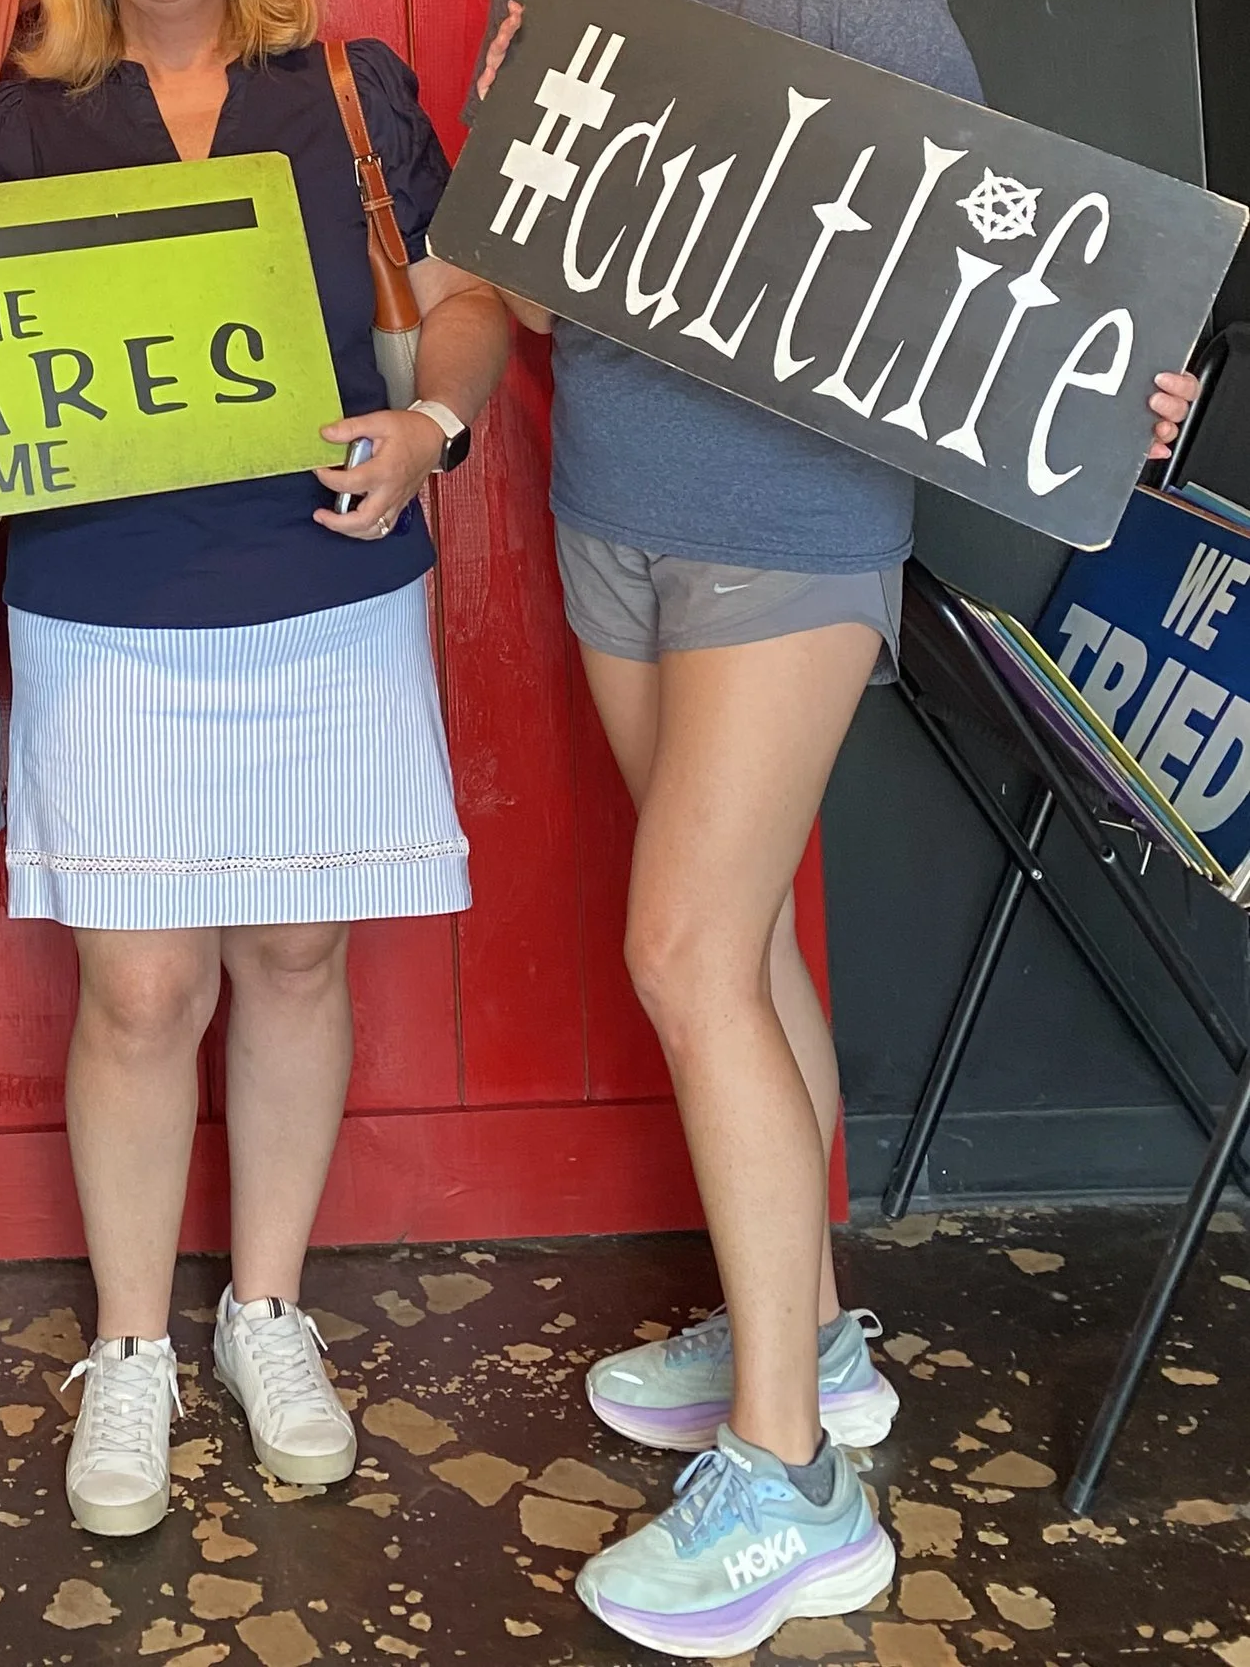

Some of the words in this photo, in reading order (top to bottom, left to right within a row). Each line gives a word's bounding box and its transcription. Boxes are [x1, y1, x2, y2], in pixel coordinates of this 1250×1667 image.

[1161, 542, 1250, 650] WE
[1056, 603, 1250, 833] TRIED
[722, 1527, 807, 1591] HOKA
